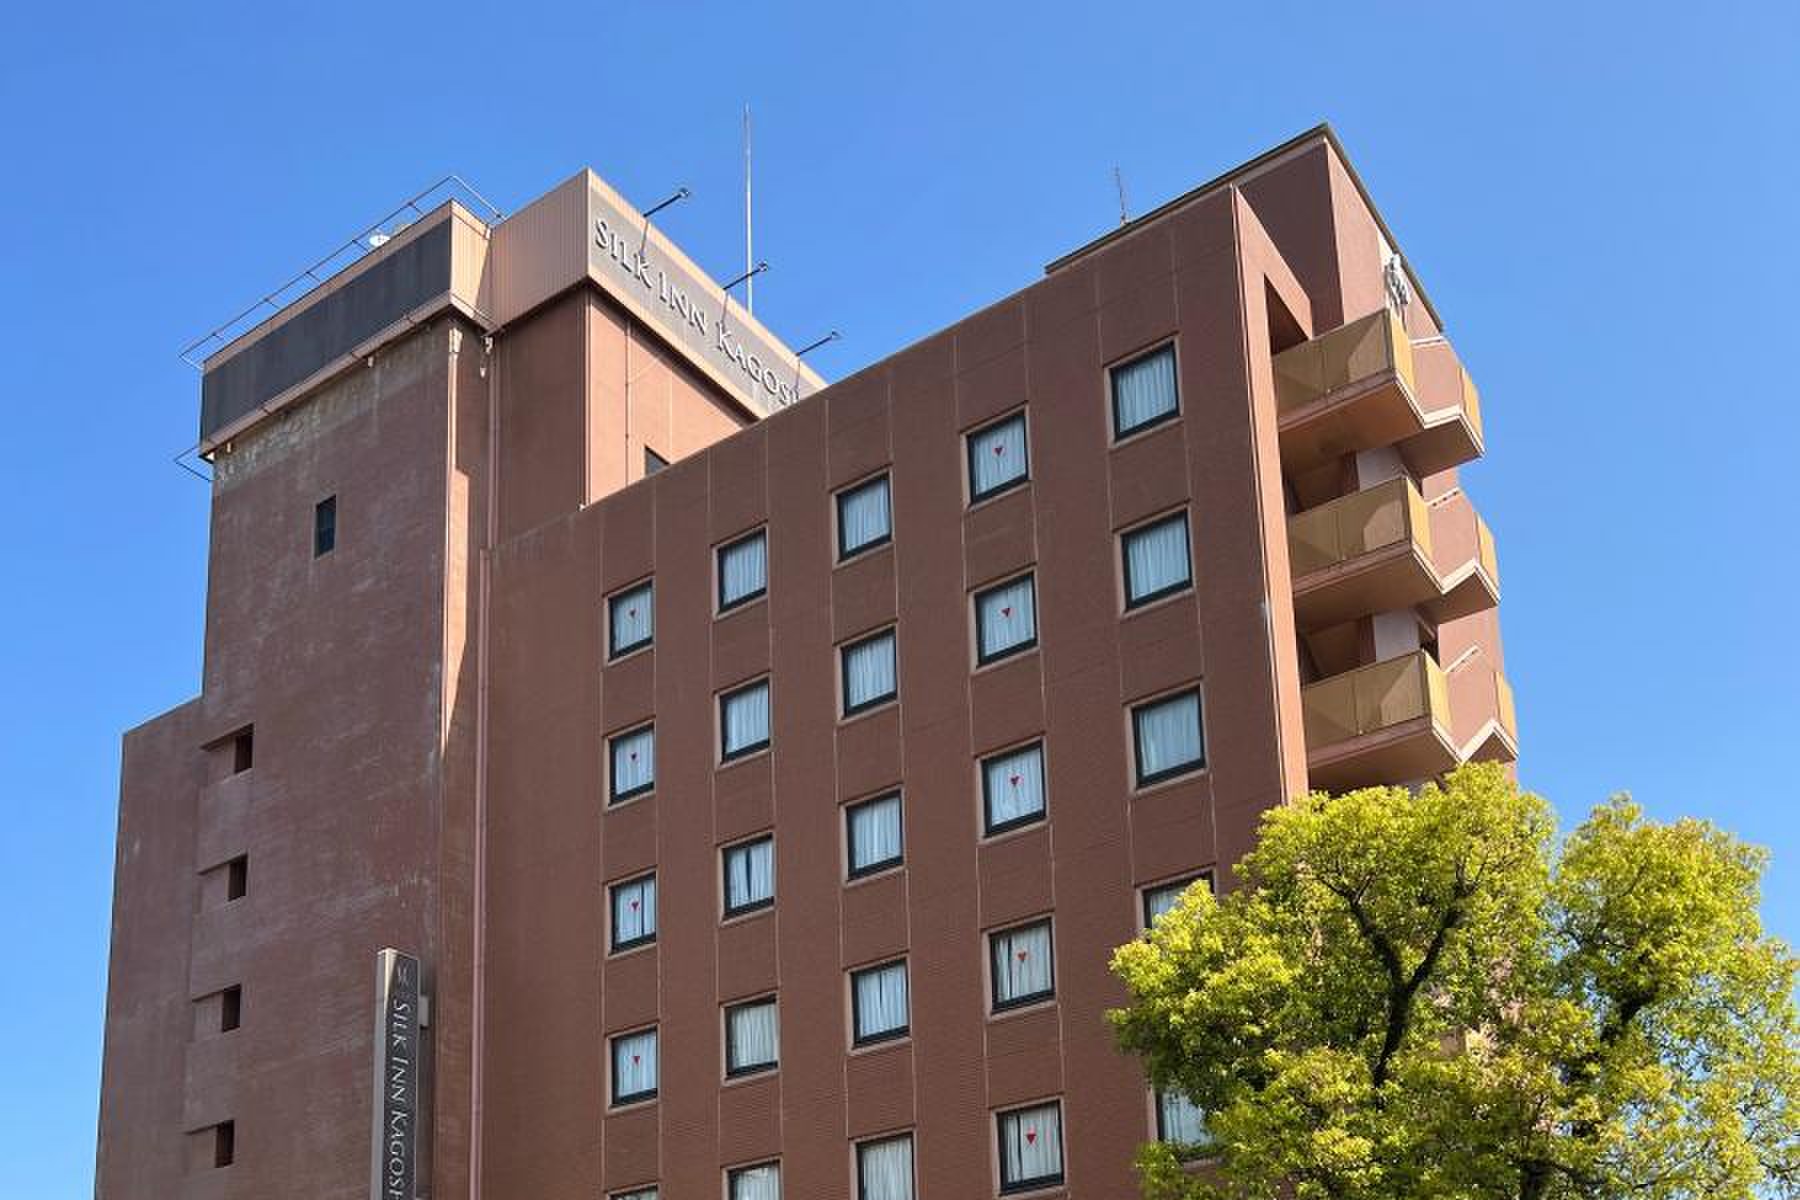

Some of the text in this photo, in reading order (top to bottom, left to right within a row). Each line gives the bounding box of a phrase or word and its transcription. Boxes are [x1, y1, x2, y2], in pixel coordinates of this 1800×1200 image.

[594, 217, 652, 289] SILK
[656, 271, 707, 336] INN
[393, 999, 411, 1048] SILK
[391, 1056, 409, 1102] INN
